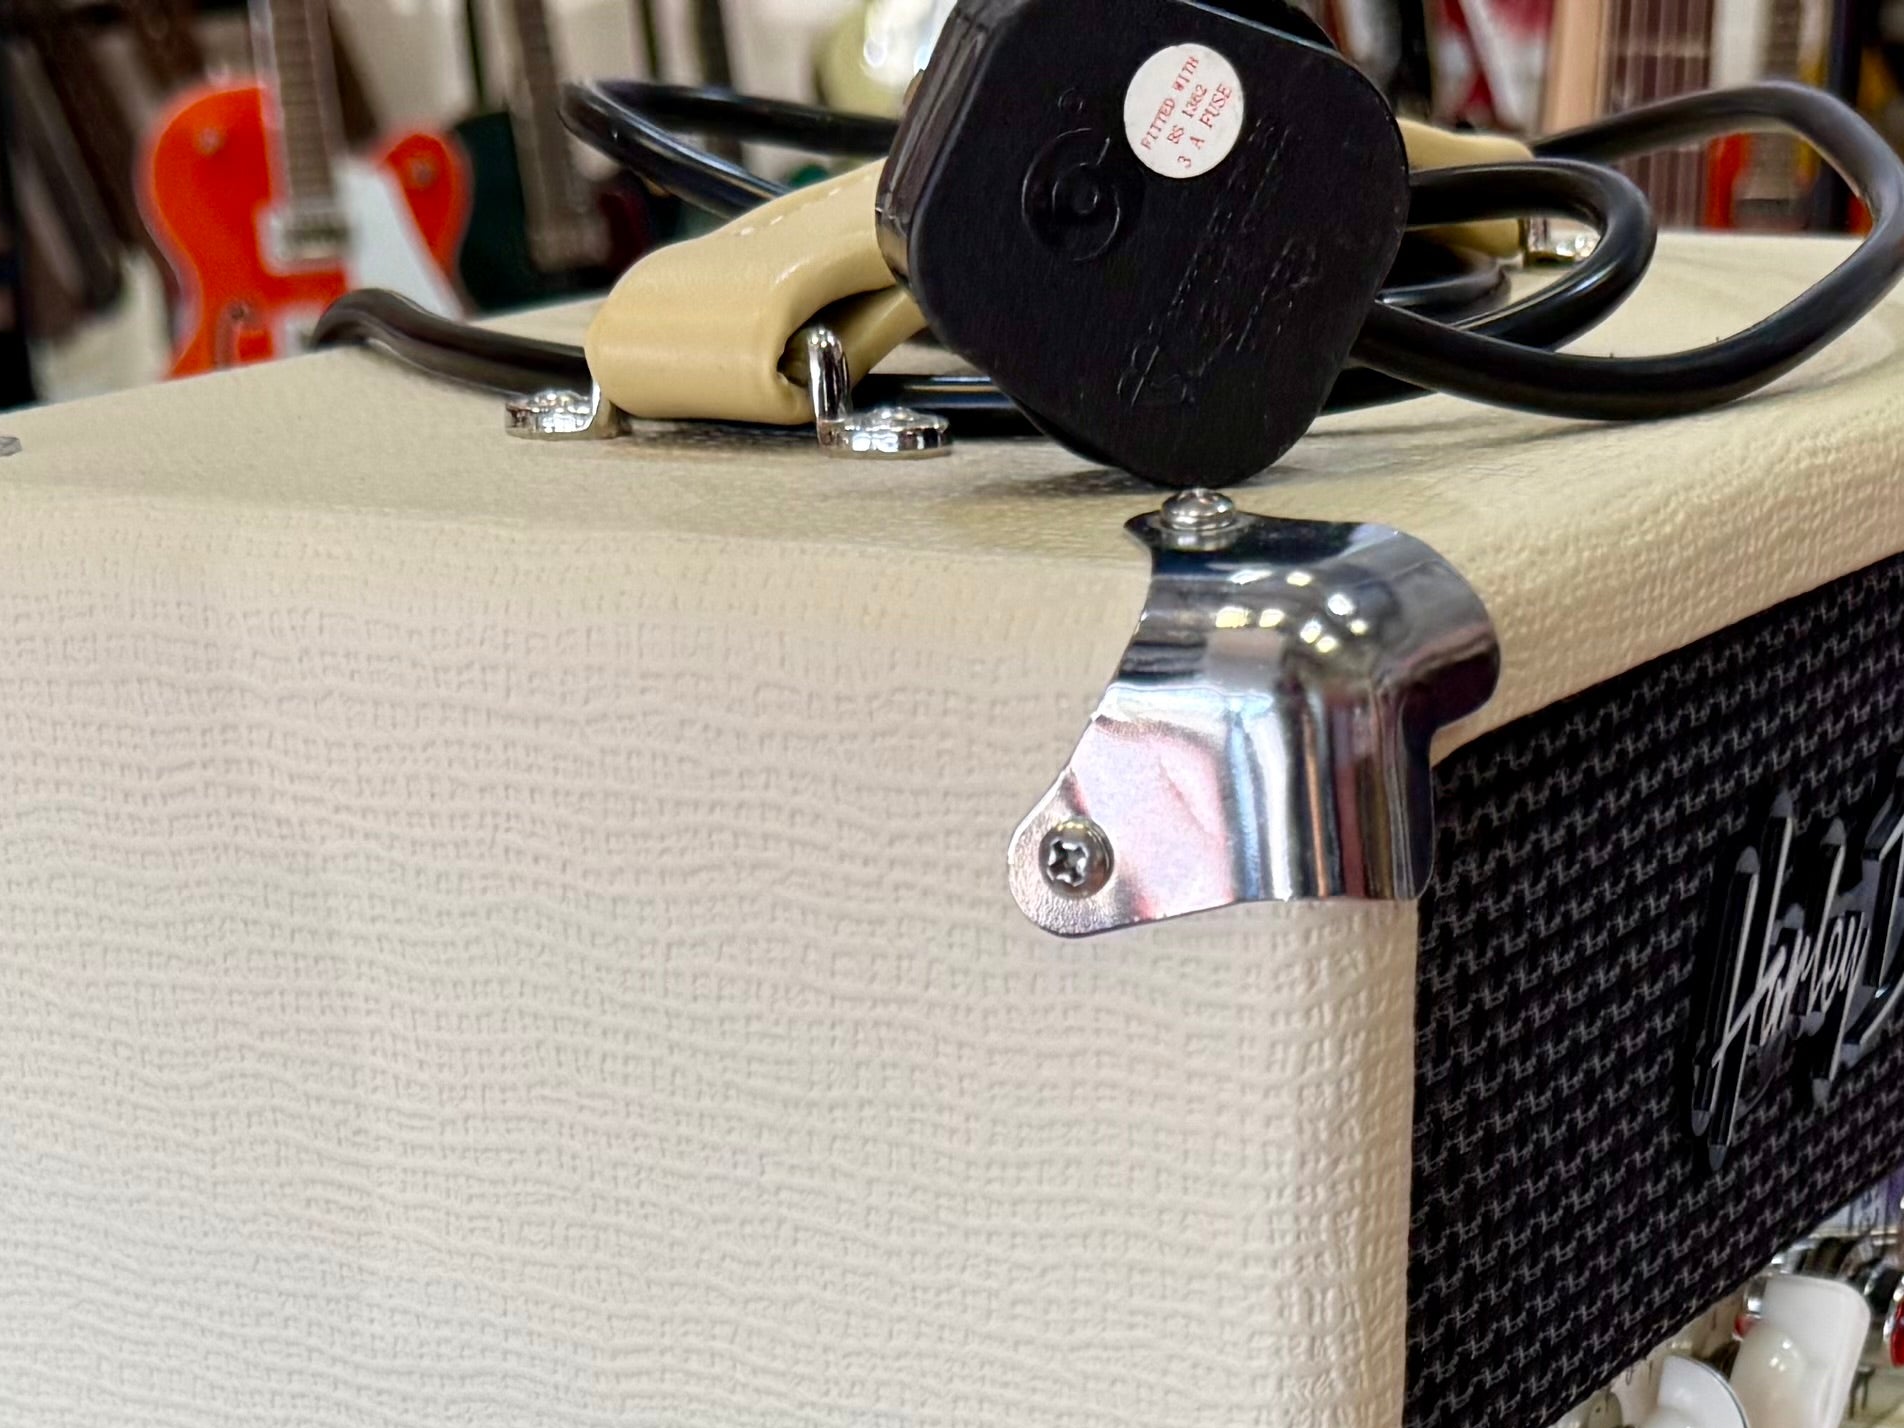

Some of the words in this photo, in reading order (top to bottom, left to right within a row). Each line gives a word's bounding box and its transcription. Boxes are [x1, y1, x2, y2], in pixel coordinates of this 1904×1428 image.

[1140, 97, 1176, 151] FITTED
[1172, 56, 1200, 92] WITH
[1167, 124, 1185, 145] BS
[1177, 155, 1192, 169] 3
[1189, 135, 1206, 151] A
[1199, 82, 1233, 129] FUSE
